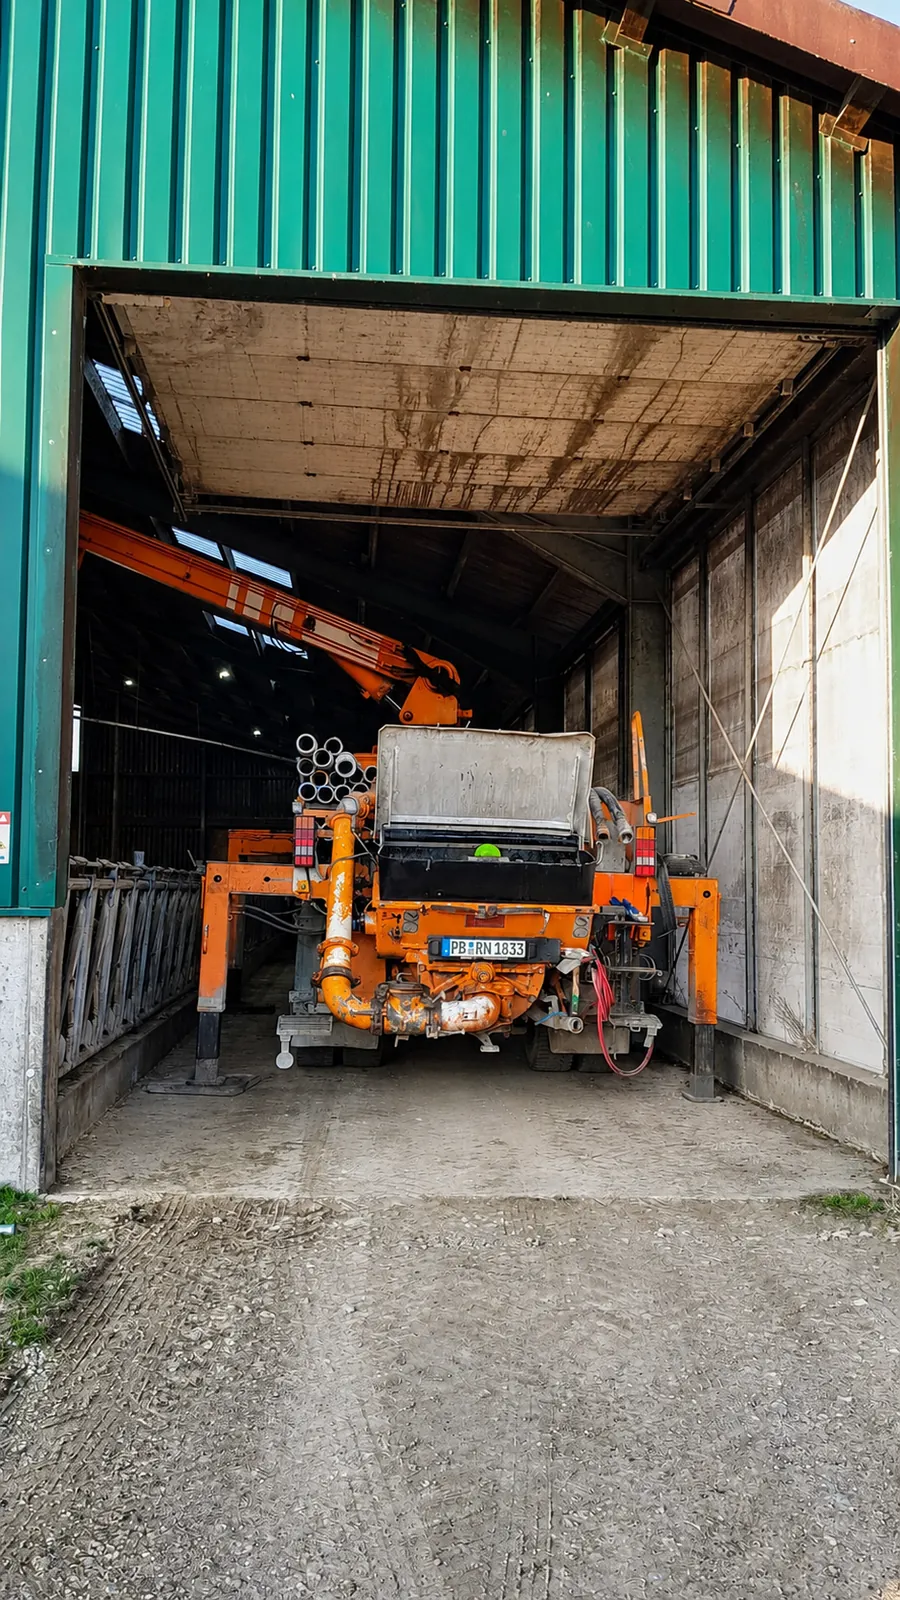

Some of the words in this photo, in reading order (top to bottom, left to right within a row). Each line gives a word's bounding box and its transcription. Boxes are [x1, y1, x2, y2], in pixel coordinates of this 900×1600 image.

[451, 940, 466, 954] PB
[475, 941, 491, 955] RN
[494, 942, 524, 956] 1833
